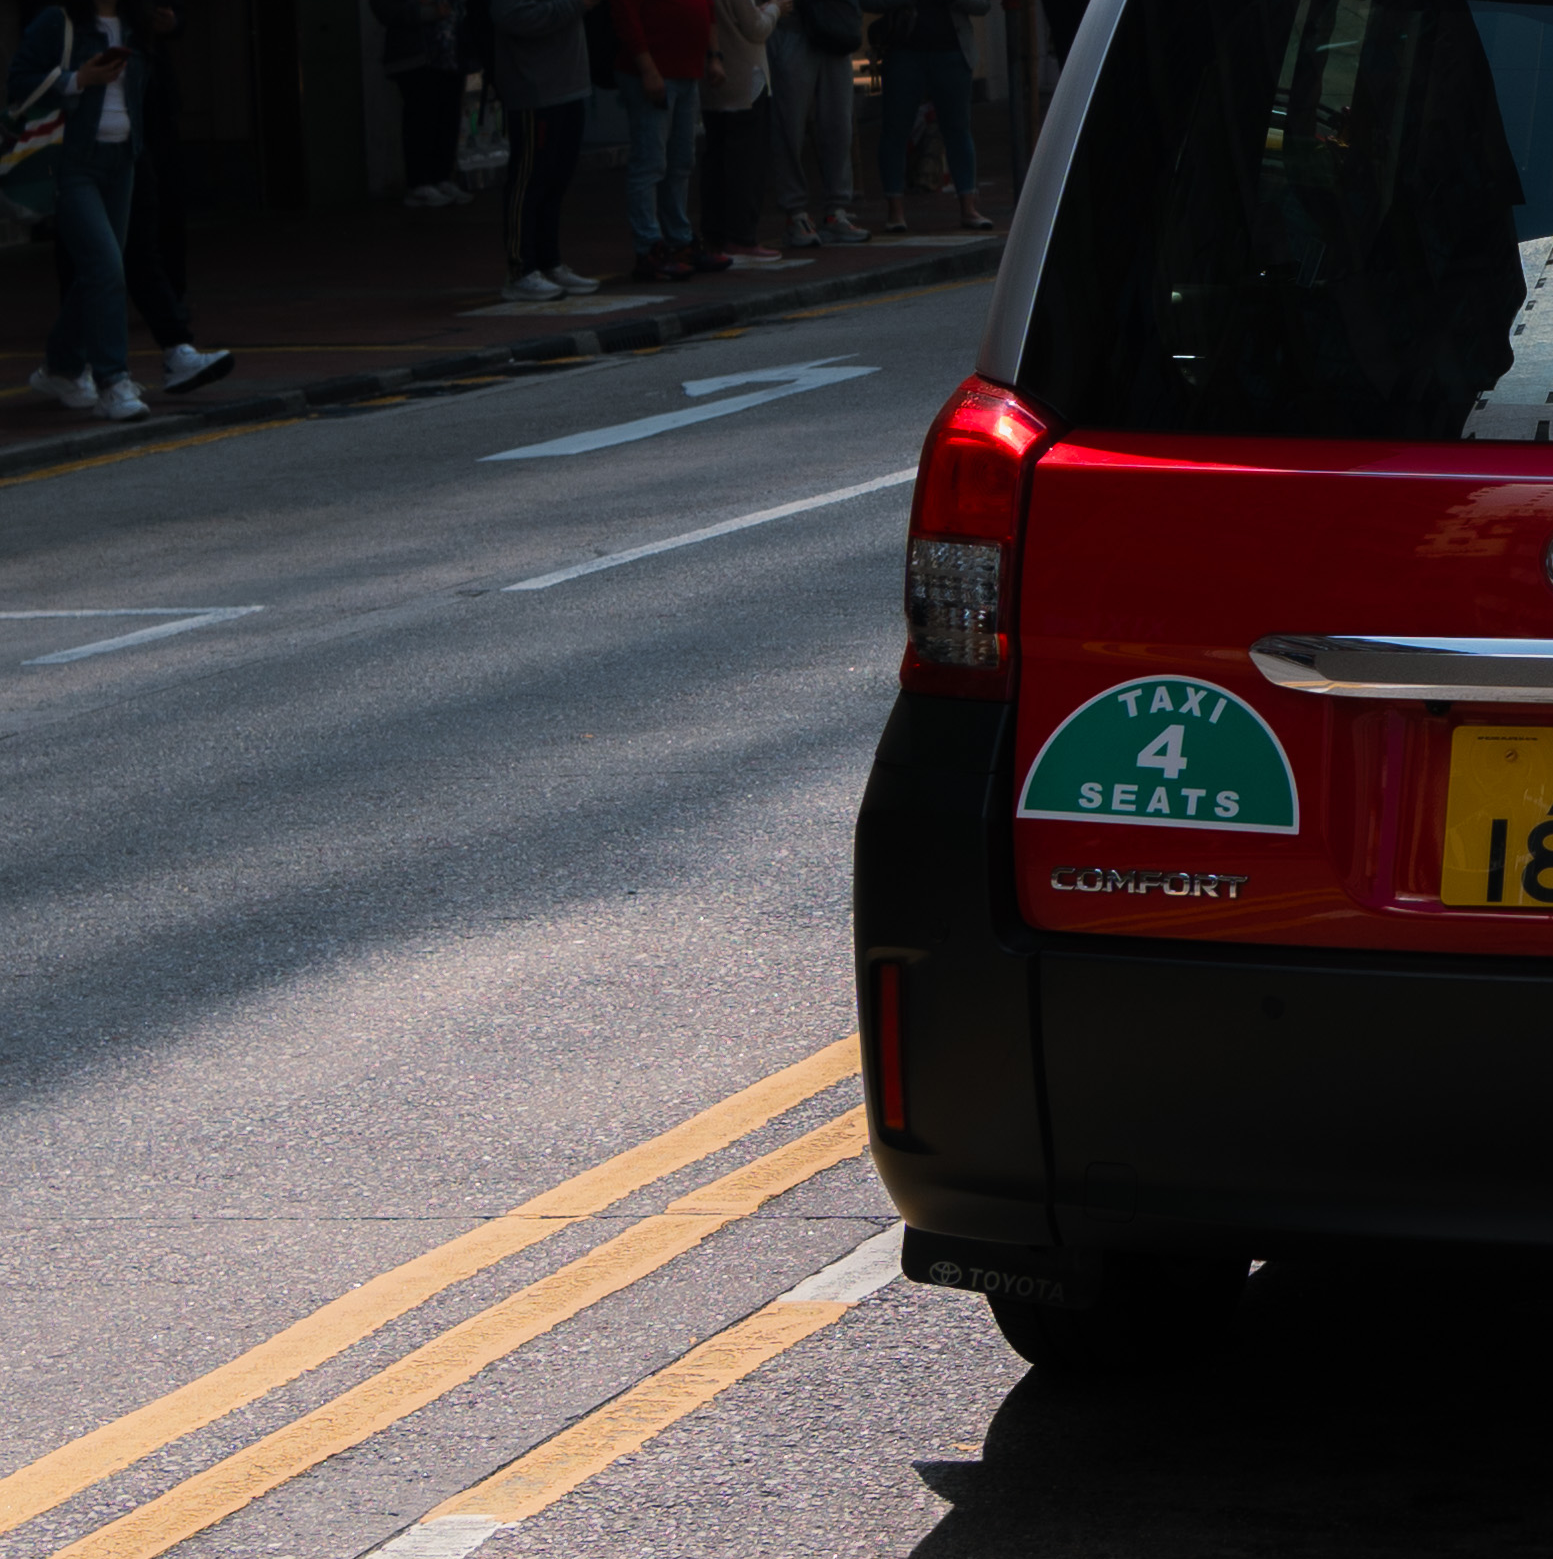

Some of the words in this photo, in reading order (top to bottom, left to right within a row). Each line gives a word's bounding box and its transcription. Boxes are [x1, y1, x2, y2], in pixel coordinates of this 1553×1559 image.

[1117, 686, 1228, 725] TAXI
[1136, 724, 1189, 780] 4
[1078, 781, 1240, 818] SEATS
[1050, 867, 1249, 900] COMFORT
